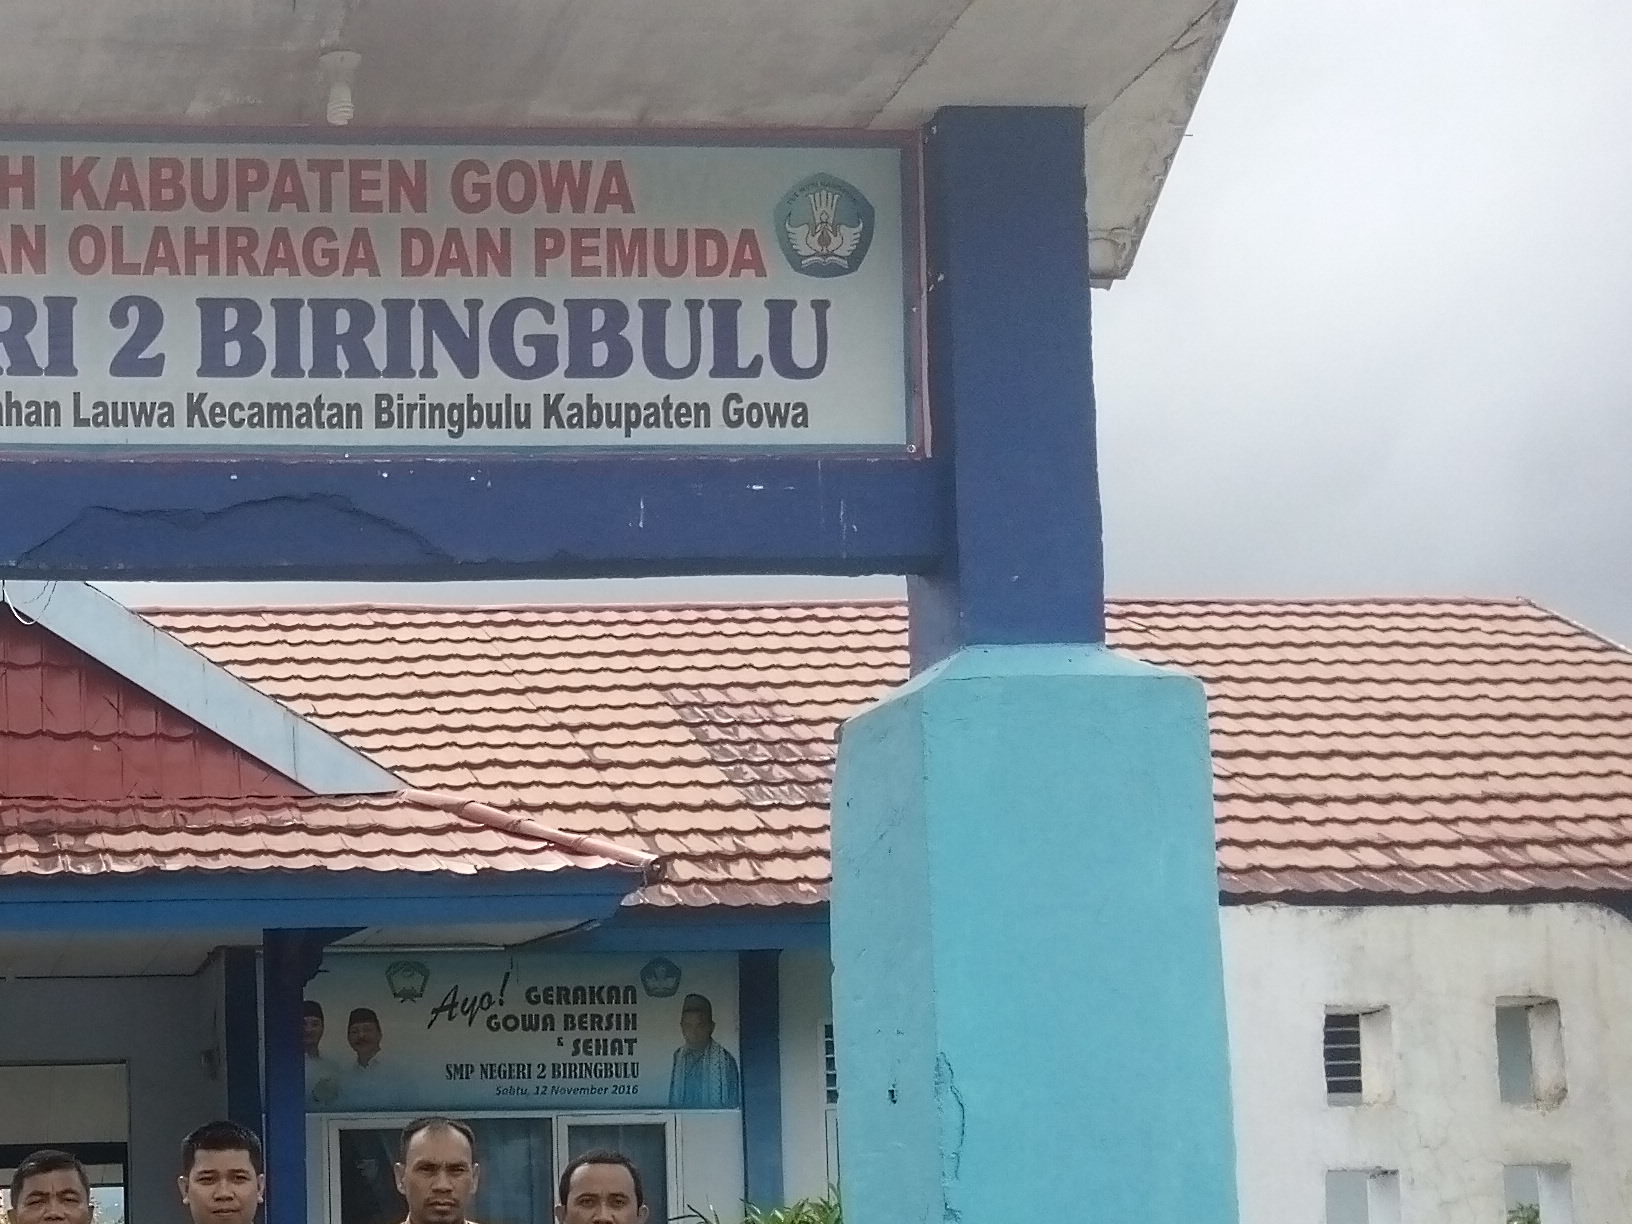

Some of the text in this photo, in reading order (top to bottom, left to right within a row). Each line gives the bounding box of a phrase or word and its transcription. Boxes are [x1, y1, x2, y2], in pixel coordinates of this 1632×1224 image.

[61, 156, 427, 213] KABUPATEN
[451, 159, 635, 214] GOWA
[68, 224, 381, 277] OLAHRAGA
[401, 227, 511, 277] DAN
[534, 227, 767, 278] PEMUDA
[109, 295, 165, 377] 2
[196, 297, 831, 380] BIRINGBULU
[73, 392, 174, 428] Lauwa
[187, 393, 362, 429] Kecamatan
[375, 393, 531, 438] Biringbulu
[543, 393, 710, 438] Kabupaten
[723, 393, 808, 428] Gowa
[427, 971, 510, 1029] Ayo!
[525, 985, 637, 1005] GERAKAN
[486, 1013, 637, 1032] GOWA BERSIH
[572, 1038, 637, 1056] SEHAT
[446, 1062, 639, 1080] SMP NEGERI 2 BIRINGBULU
[533, 1084, 548, 1097] 12
[550, 1083, 609, 1096] November
[611, 1082, 640, 1096] 2016
